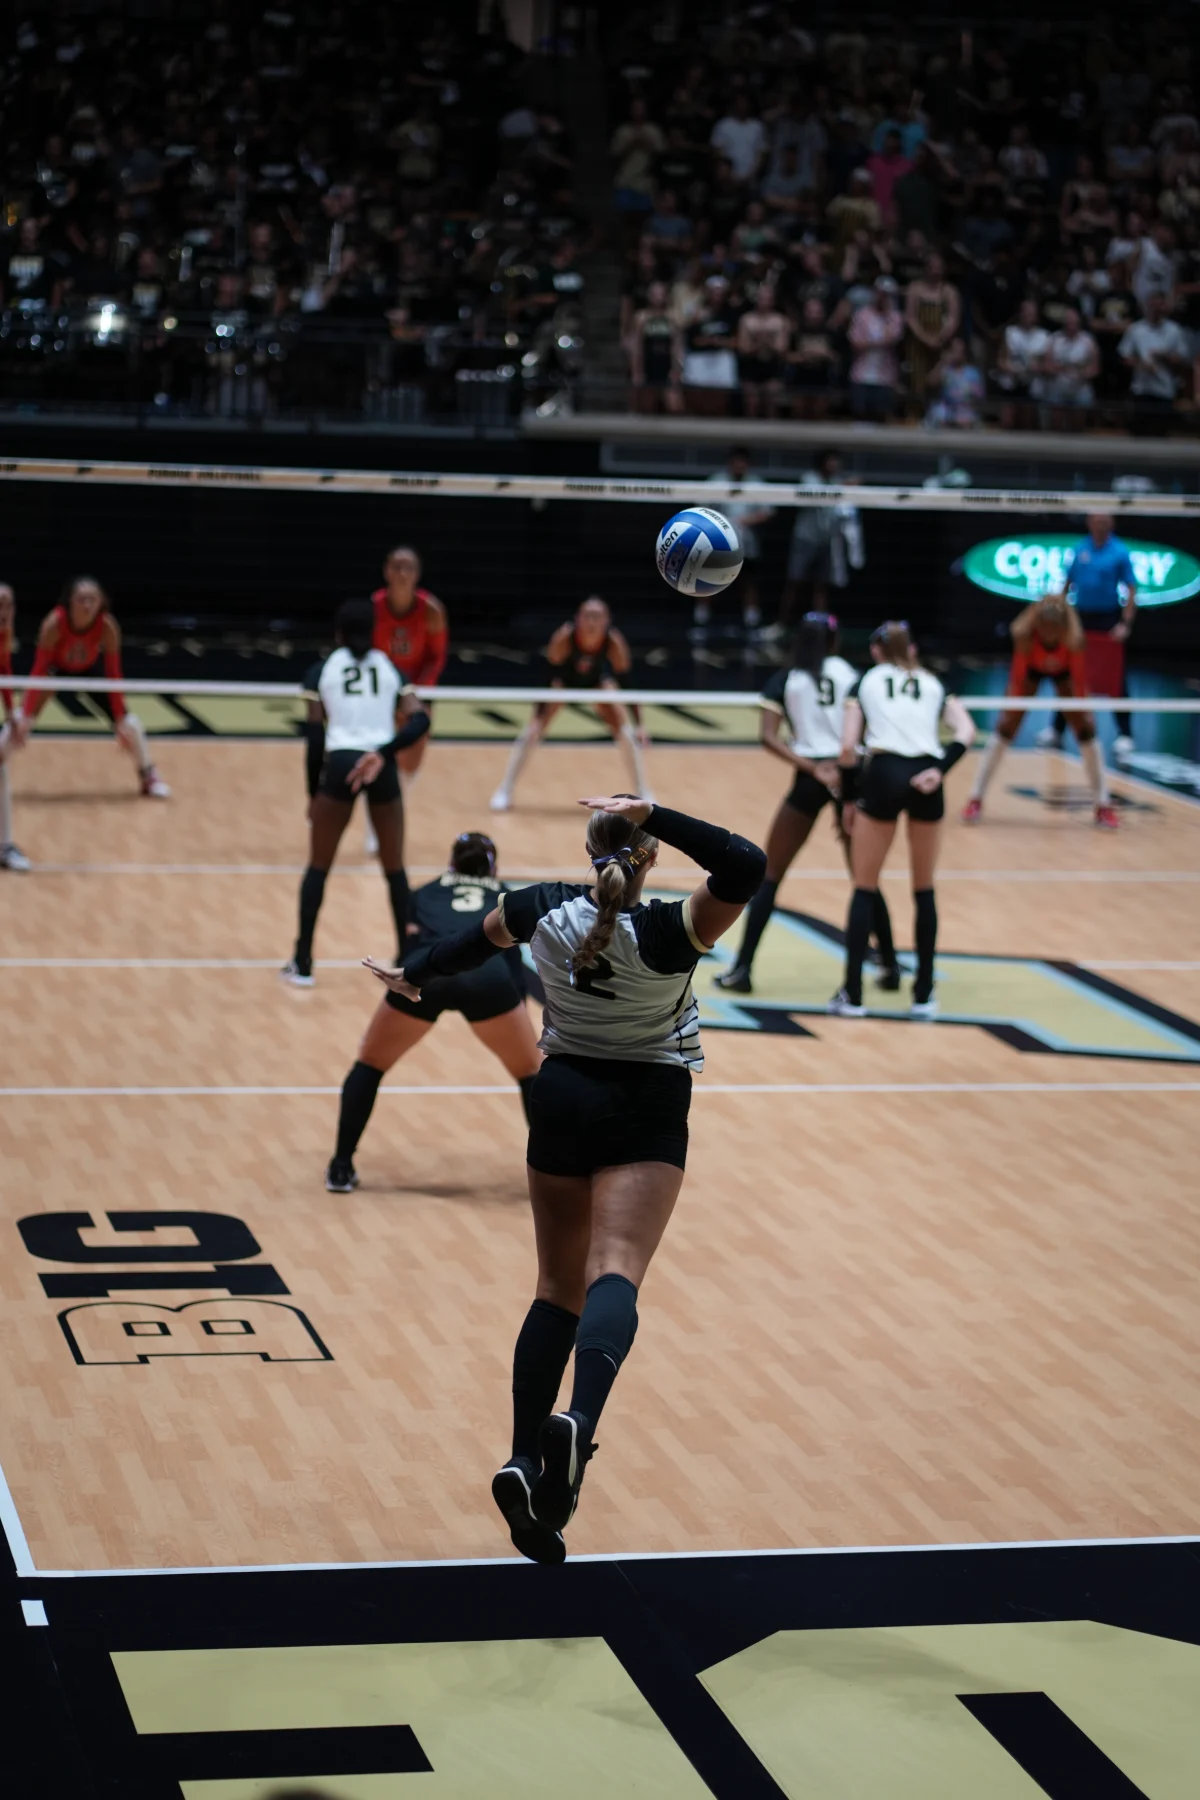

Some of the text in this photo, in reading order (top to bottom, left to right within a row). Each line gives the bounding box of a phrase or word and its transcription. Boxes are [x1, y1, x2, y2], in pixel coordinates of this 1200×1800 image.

[658, 530, 679, 575] molten
[342, 666, 379, 696] 21
[817, 678, 835, 706] 9
[884, 676, 921, 701] 14
[451, 885, 485, 912] 3
